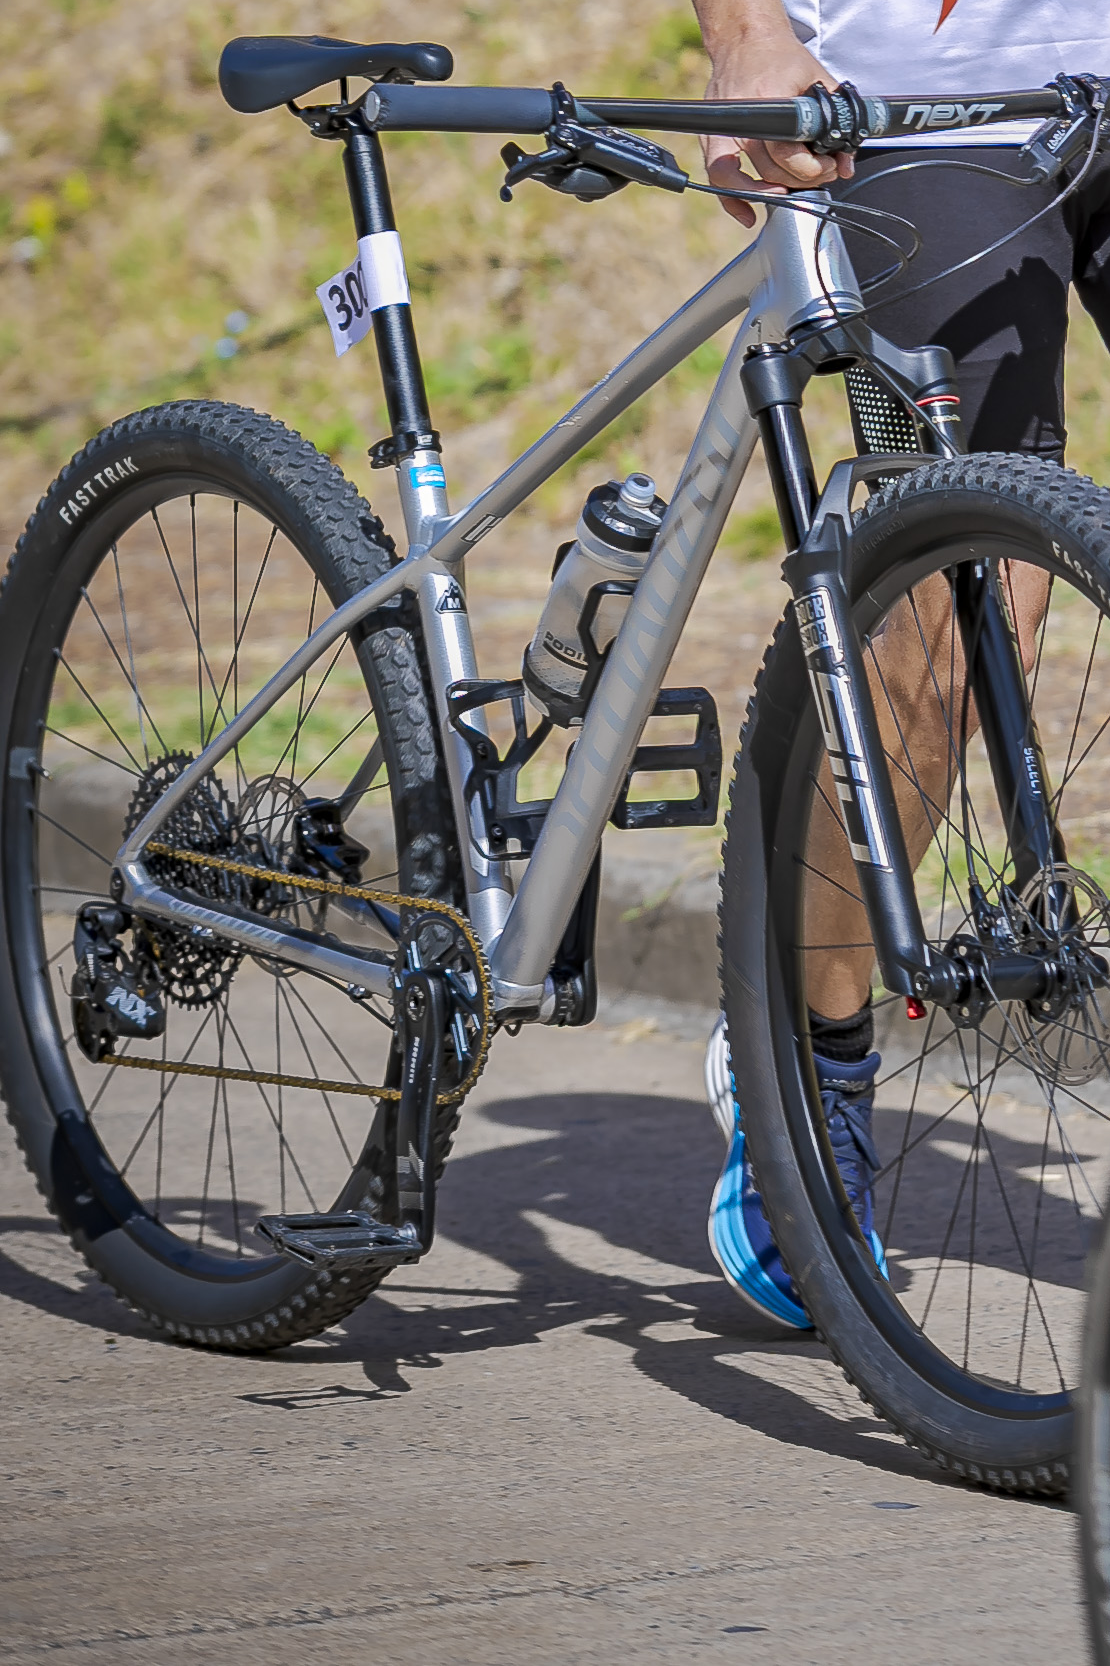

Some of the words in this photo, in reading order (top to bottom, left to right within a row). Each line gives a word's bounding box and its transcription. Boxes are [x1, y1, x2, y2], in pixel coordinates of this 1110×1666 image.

[59, 481, 98, 526] FAST
[93, 456, 140, 489] TRAK
[545, 630, 589, 662] PODI
